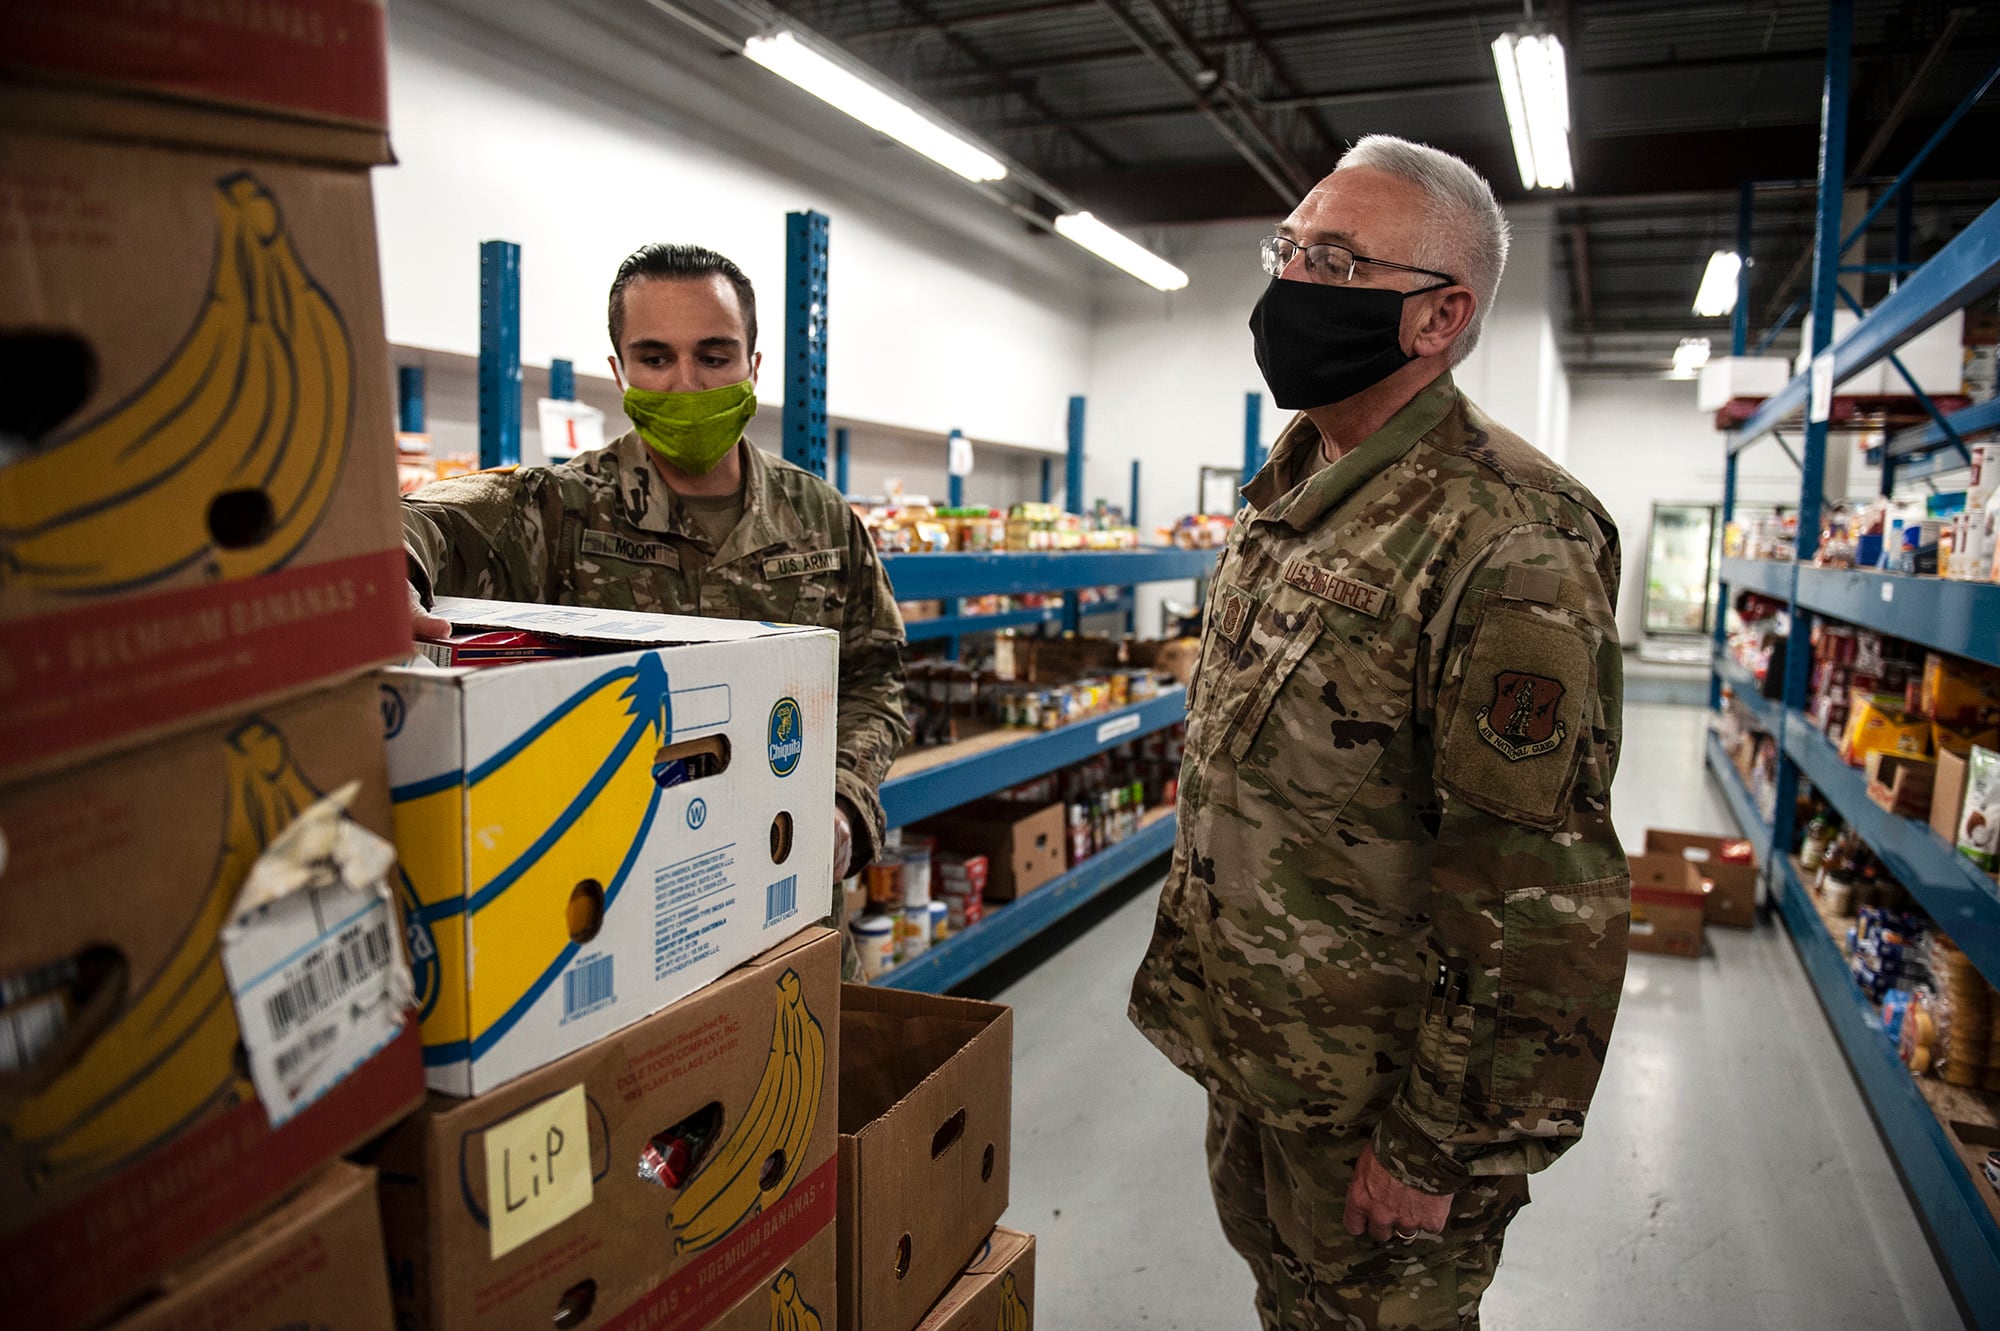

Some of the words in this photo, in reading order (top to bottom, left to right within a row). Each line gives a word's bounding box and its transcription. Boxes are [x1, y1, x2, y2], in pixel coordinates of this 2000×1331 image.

[615, 538, 657, 559] MOON
[803, 552, 834, 569] ARMY
[1309, 565, 1330, 593] AIR
[1325, 575, 1377, 612] FORCE
[769, 737, 801, 762] Chiquita
[1481, 727, 1494, 740] AIR
[1494, 737, 1529, 758] NATIONAL
[1532, 740, 1555, 753] GUARD
[646, 1052, 675, 1073] FOOD
[698, 1227, 761, 1289] PREMIUM
[763, 1184, 817, 1241] BANANAS
